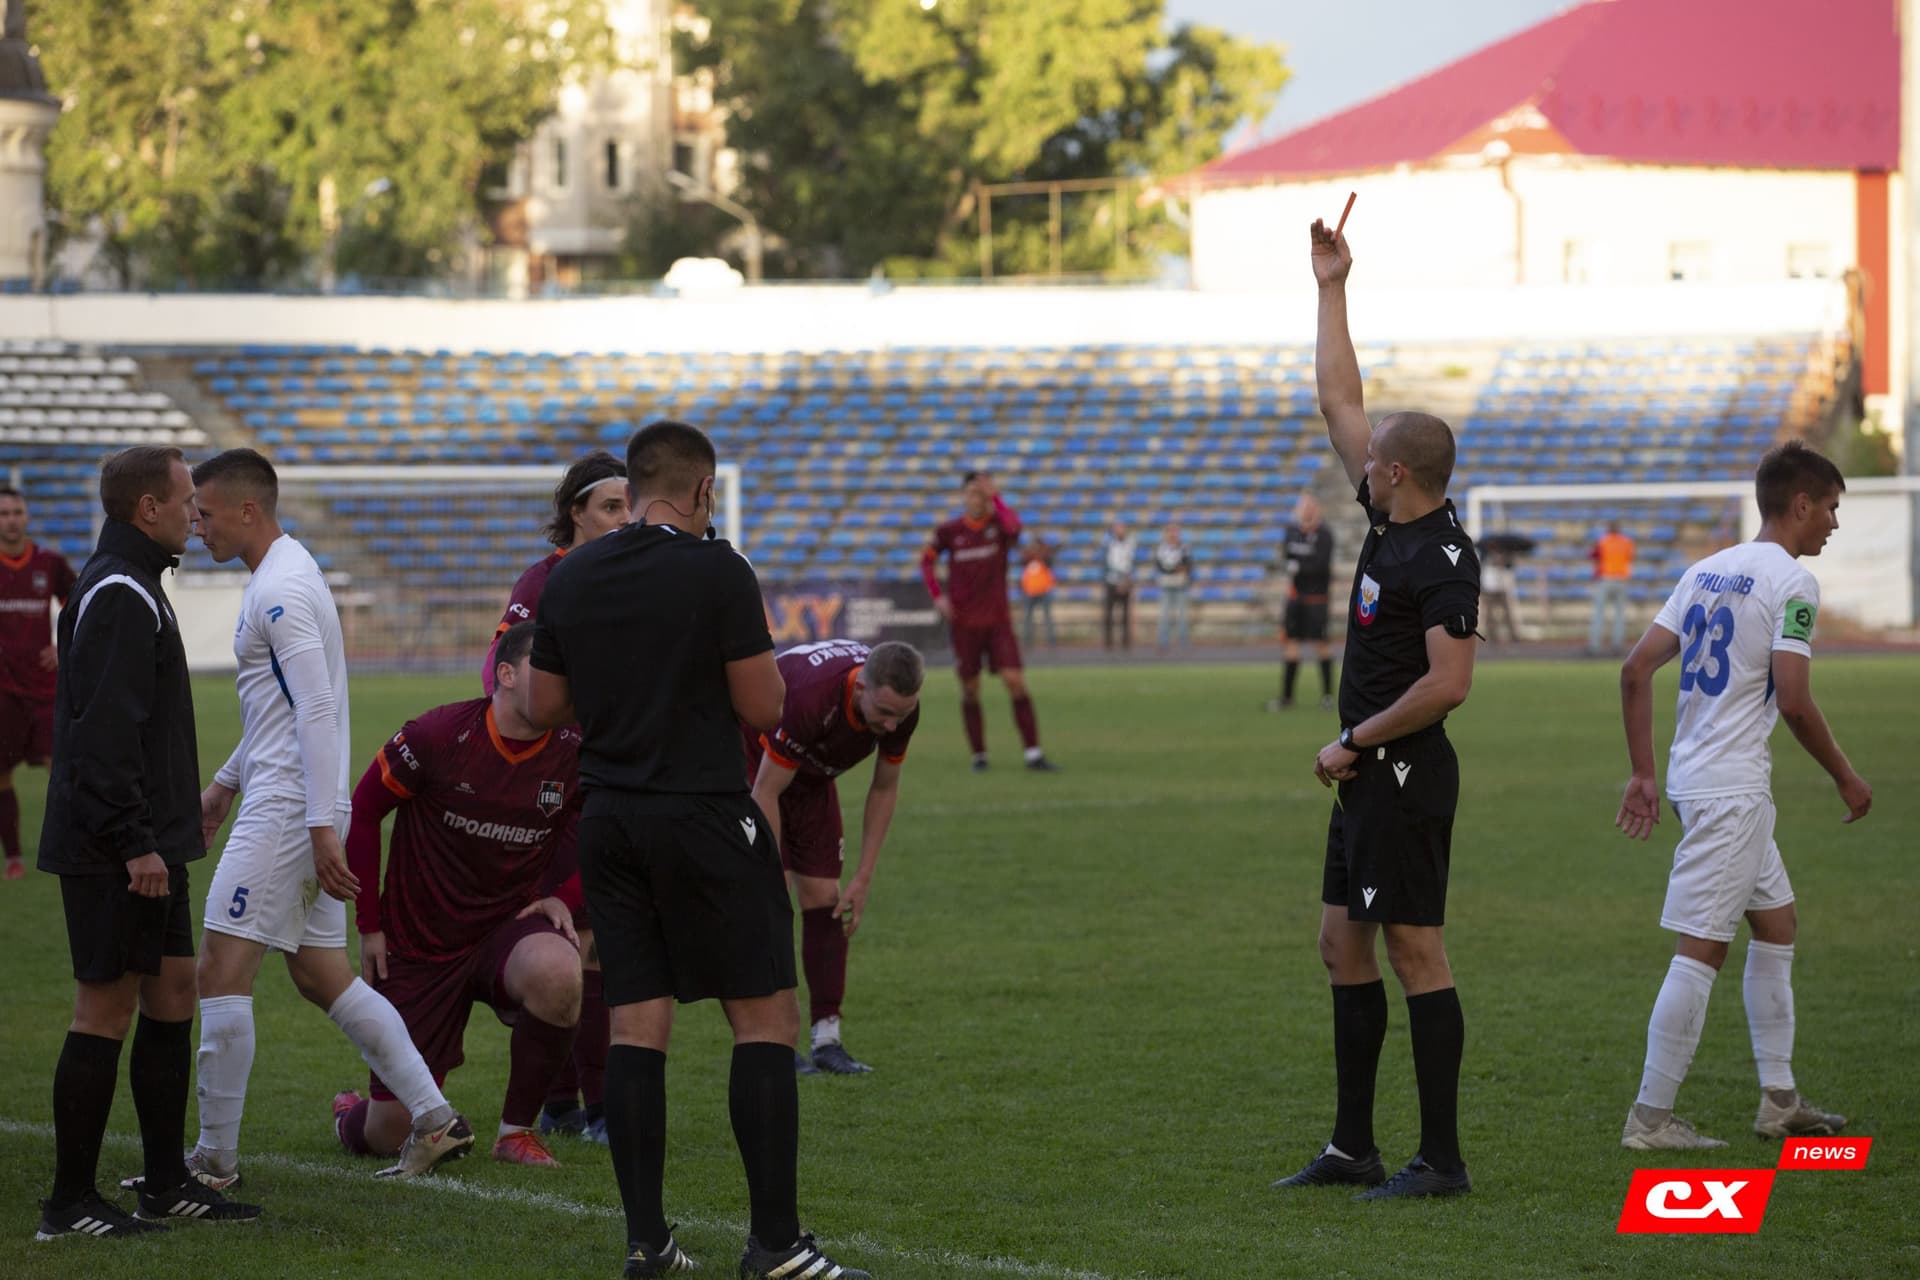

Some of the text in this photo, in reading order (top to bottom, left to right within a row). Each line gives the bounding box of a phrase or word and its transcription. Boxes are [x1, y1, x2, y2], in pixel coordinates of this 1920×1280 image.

[1680, 603, 1734, 697] 23
[399, 743, 420, 771] ПСБ
[228, 886, 249, 919] 5
